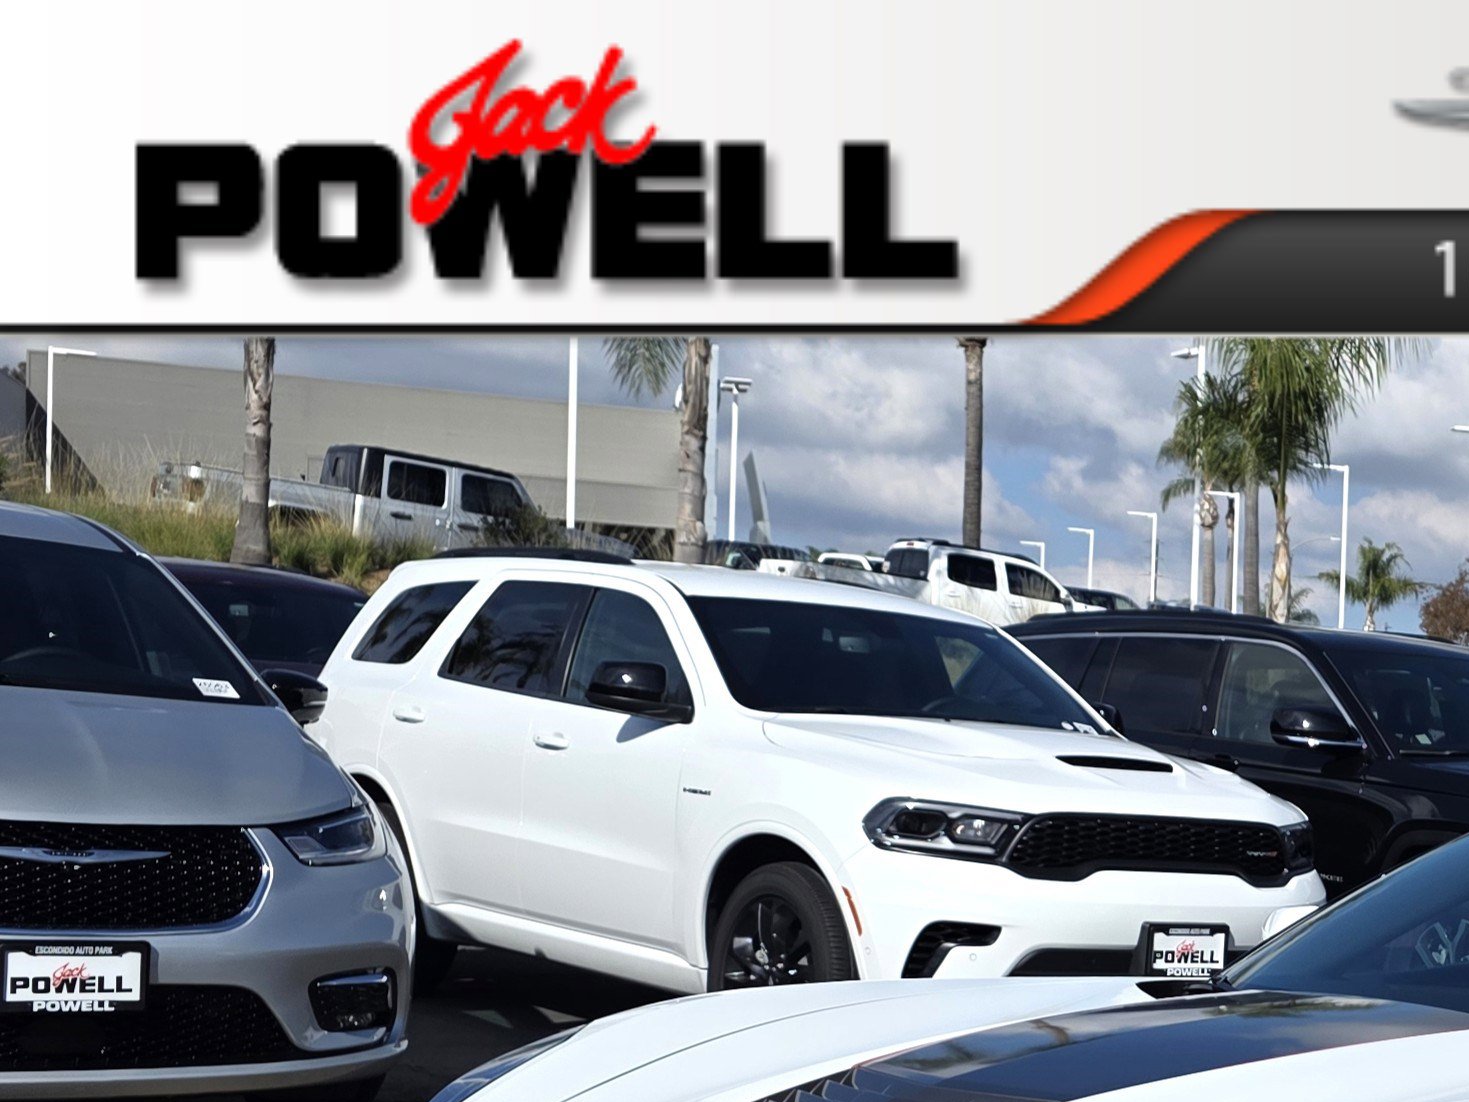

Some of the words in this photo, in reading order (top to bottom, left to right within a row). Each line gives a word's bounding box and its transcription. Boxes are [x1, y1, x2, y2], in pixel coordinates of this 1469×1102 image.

[35, 945, 75, 955] ESCONDIDO
[75, 945, 94, 955] AUTO
[94, 945, 114, 955] PARK
[1152, 950, 1219, 964] POWELL
[52, 962, 89, 988] Jack
[1166, 967, 1211, 977] POWELL
[10, 975, 133, 994] POWELL
[32, 1000, 116, 1012] POWELL
